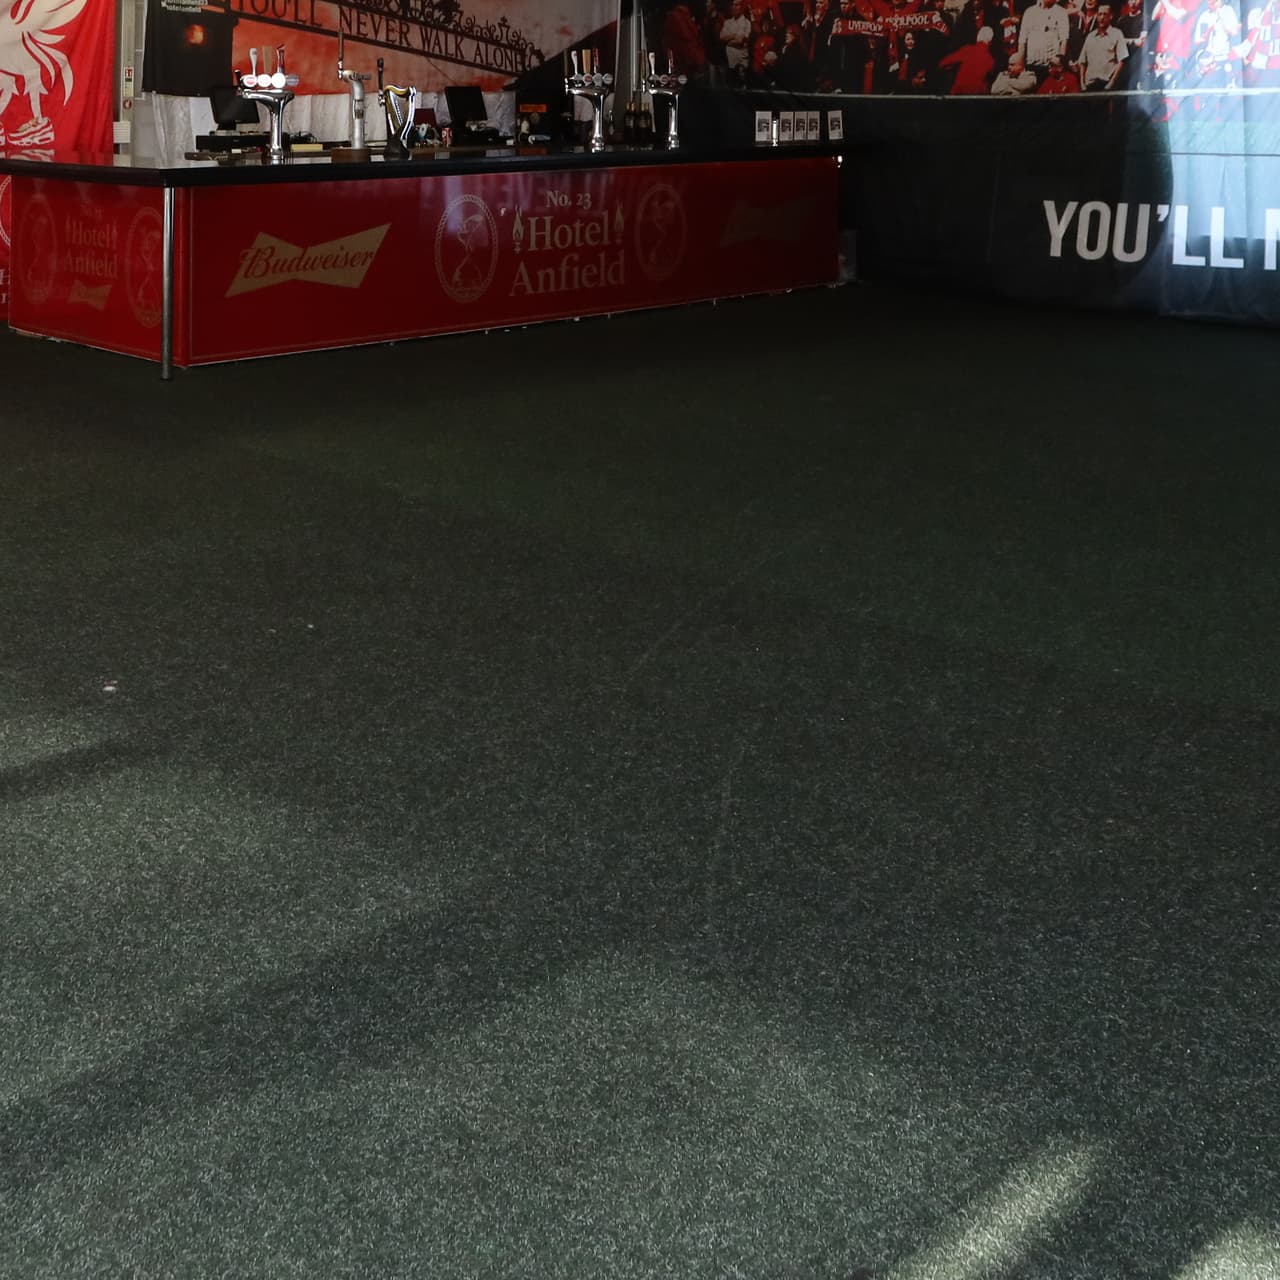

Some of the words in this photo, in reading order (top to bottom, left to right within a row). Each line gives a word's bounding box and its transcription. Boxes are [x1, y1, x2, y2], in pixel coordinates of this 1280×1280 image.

[337, 5, 414, 48] NEVER
[419, 26, 466, 60] WALK
[473, 40, 524, 73] ALONE
[546, 190, 572, 208] No.
[575, 192, 593, 209] 23
[527, 210, 612, 252] Hotel
[1042, 199, 1245, 269] YOU'LL
[239, 244, 375, 279] Budweiser
[509, 251, 626, 297] Anfield
